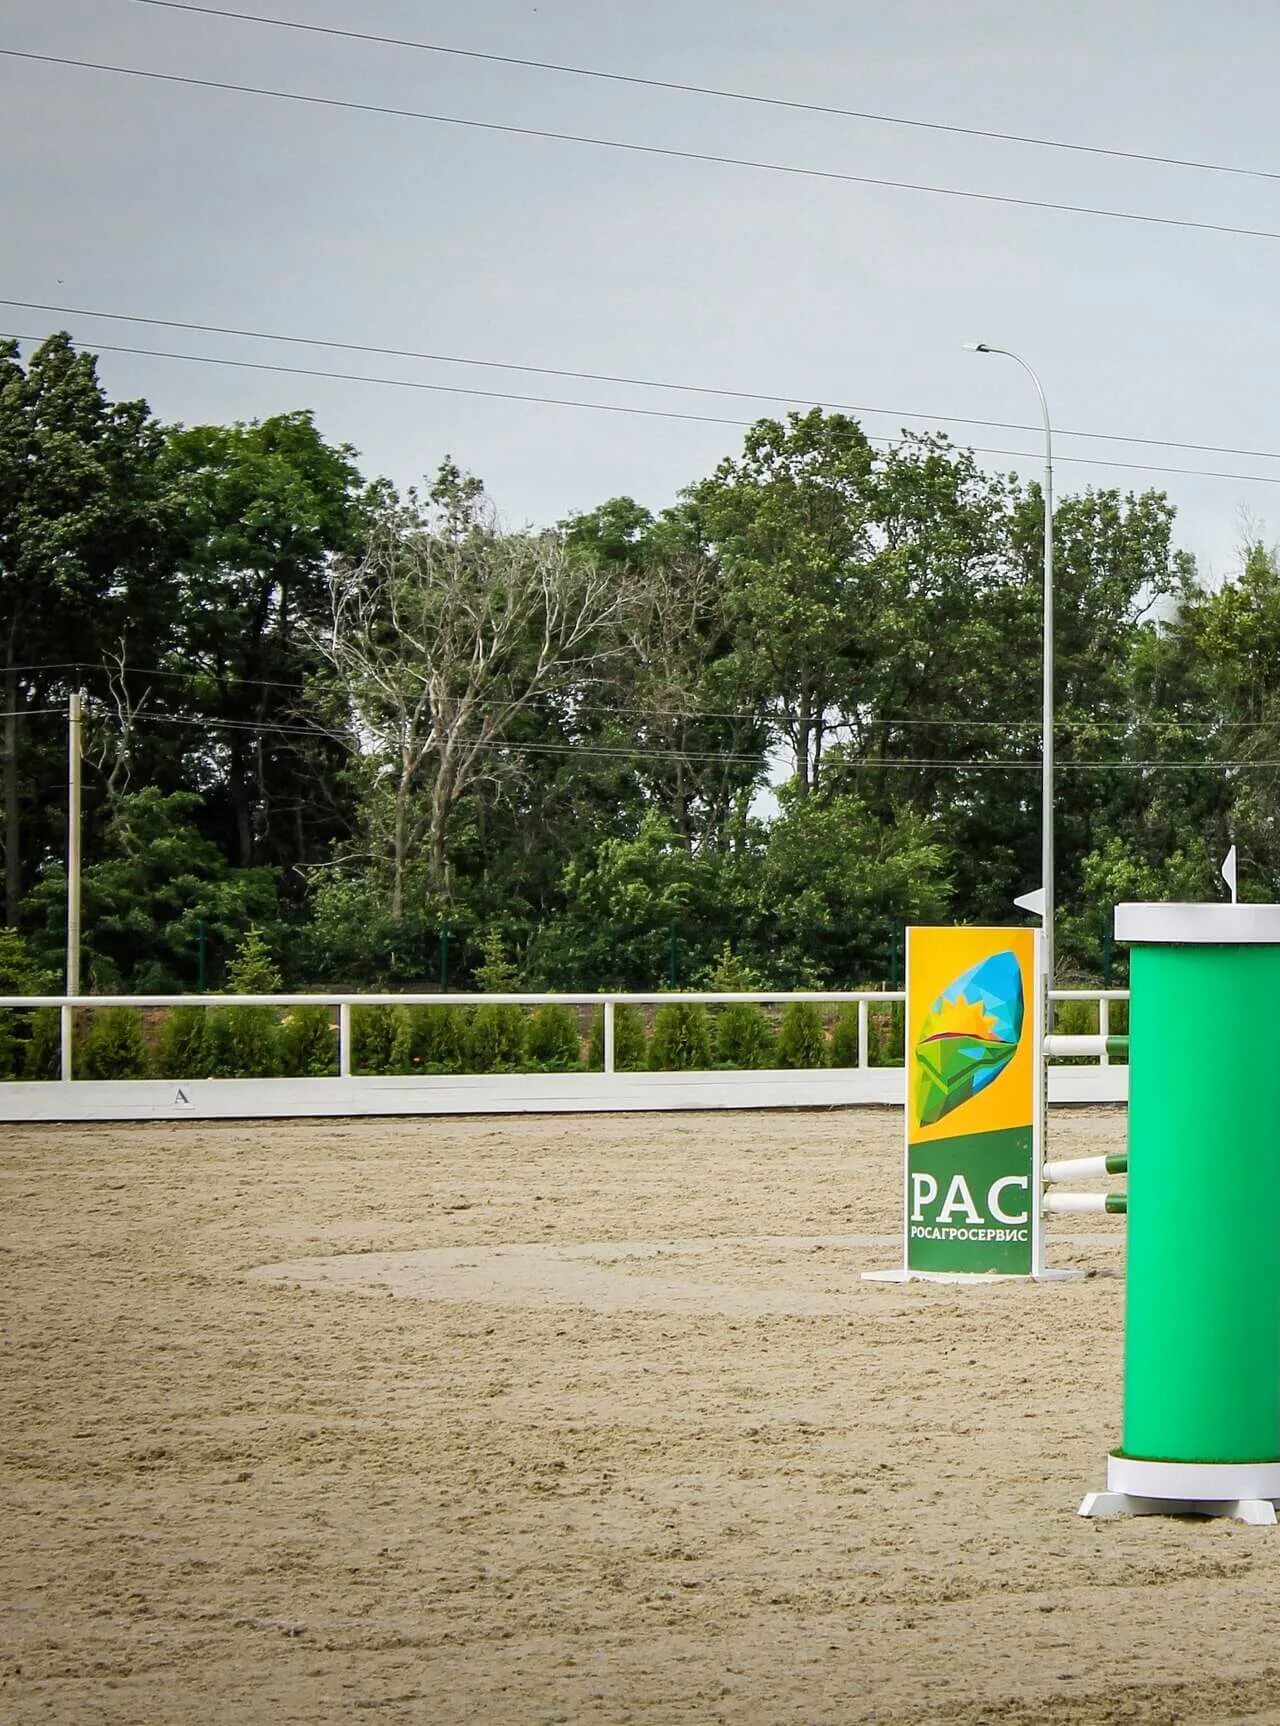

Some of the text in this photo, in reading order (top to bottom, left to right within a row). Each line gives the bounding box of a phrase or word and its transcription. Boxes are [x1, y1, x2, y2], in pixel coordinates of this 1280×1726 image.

[174, 1088, 190, 1104] A
[911, 1173, 1028, 1225] РАС
[911, 1225, 1028, 1242] РОСАГРОСЕРВИС
